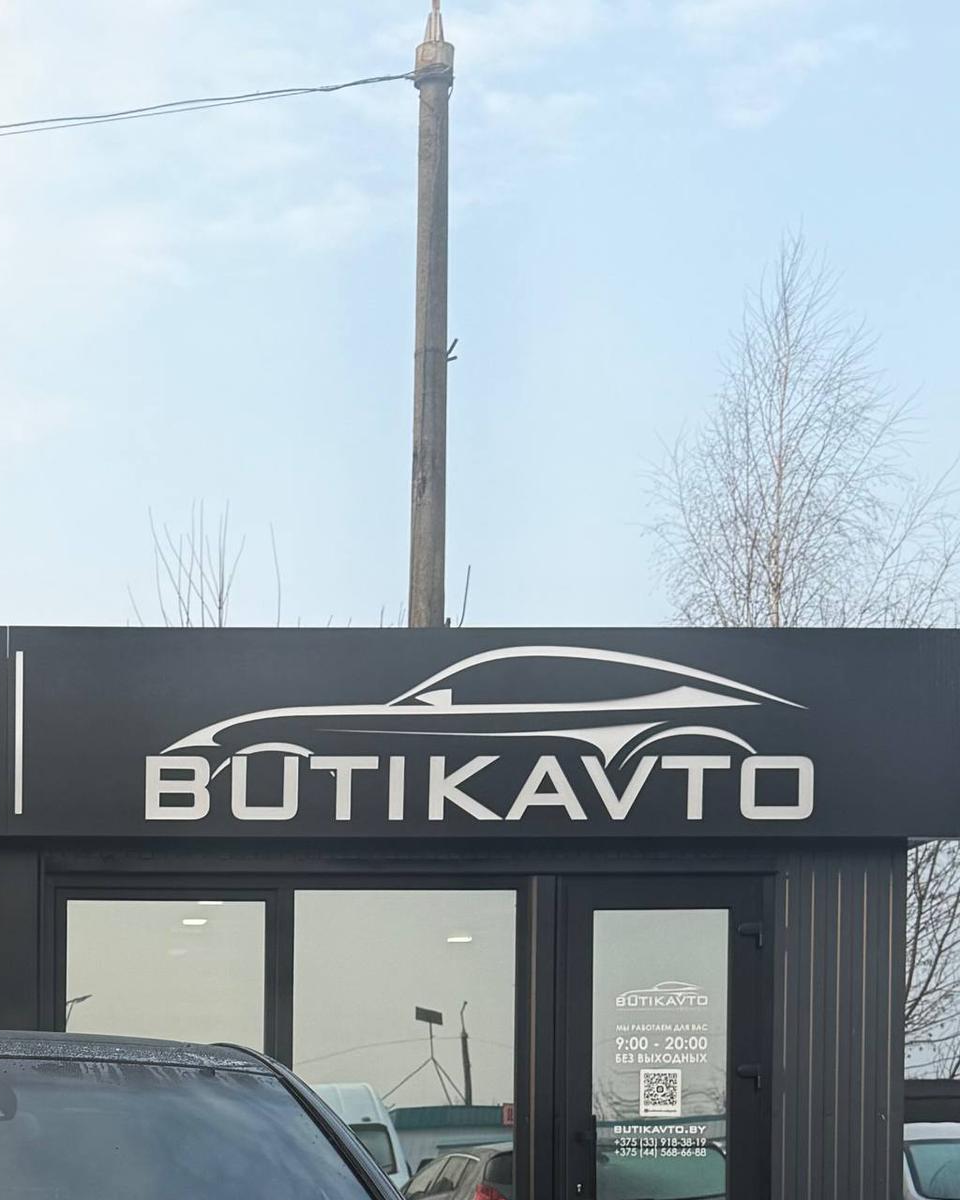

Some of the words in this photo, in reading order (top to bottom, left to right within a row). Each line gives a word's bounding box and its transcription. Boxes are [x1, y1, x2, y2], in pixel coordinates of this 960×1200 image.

[144, 755, 815, 822] BUTIKAVTO
[615, 995, 708, 1007] BUTIKAVTO
[615, 1036, 648, 1050] 9:00
[665, 1036, 708, 1050] 20:00
[615, 1053, 634, 1064] БЕЗ
[637, 1053, 707, 1064] ВЫХОДНЫХ
[614, 1125, 707, 1134] BUTIKAVTO.BY
[614, 1138, 637, 1147] +375
[639, 1137, 658, 1148] (33)
[660, 1137, 707, 1147] 918-38-19
[614, 1148, 637, 1157] +375
[639, 1147, 658, 1158] (44)
[660, 1147, 707, 1157] 568-66-88
